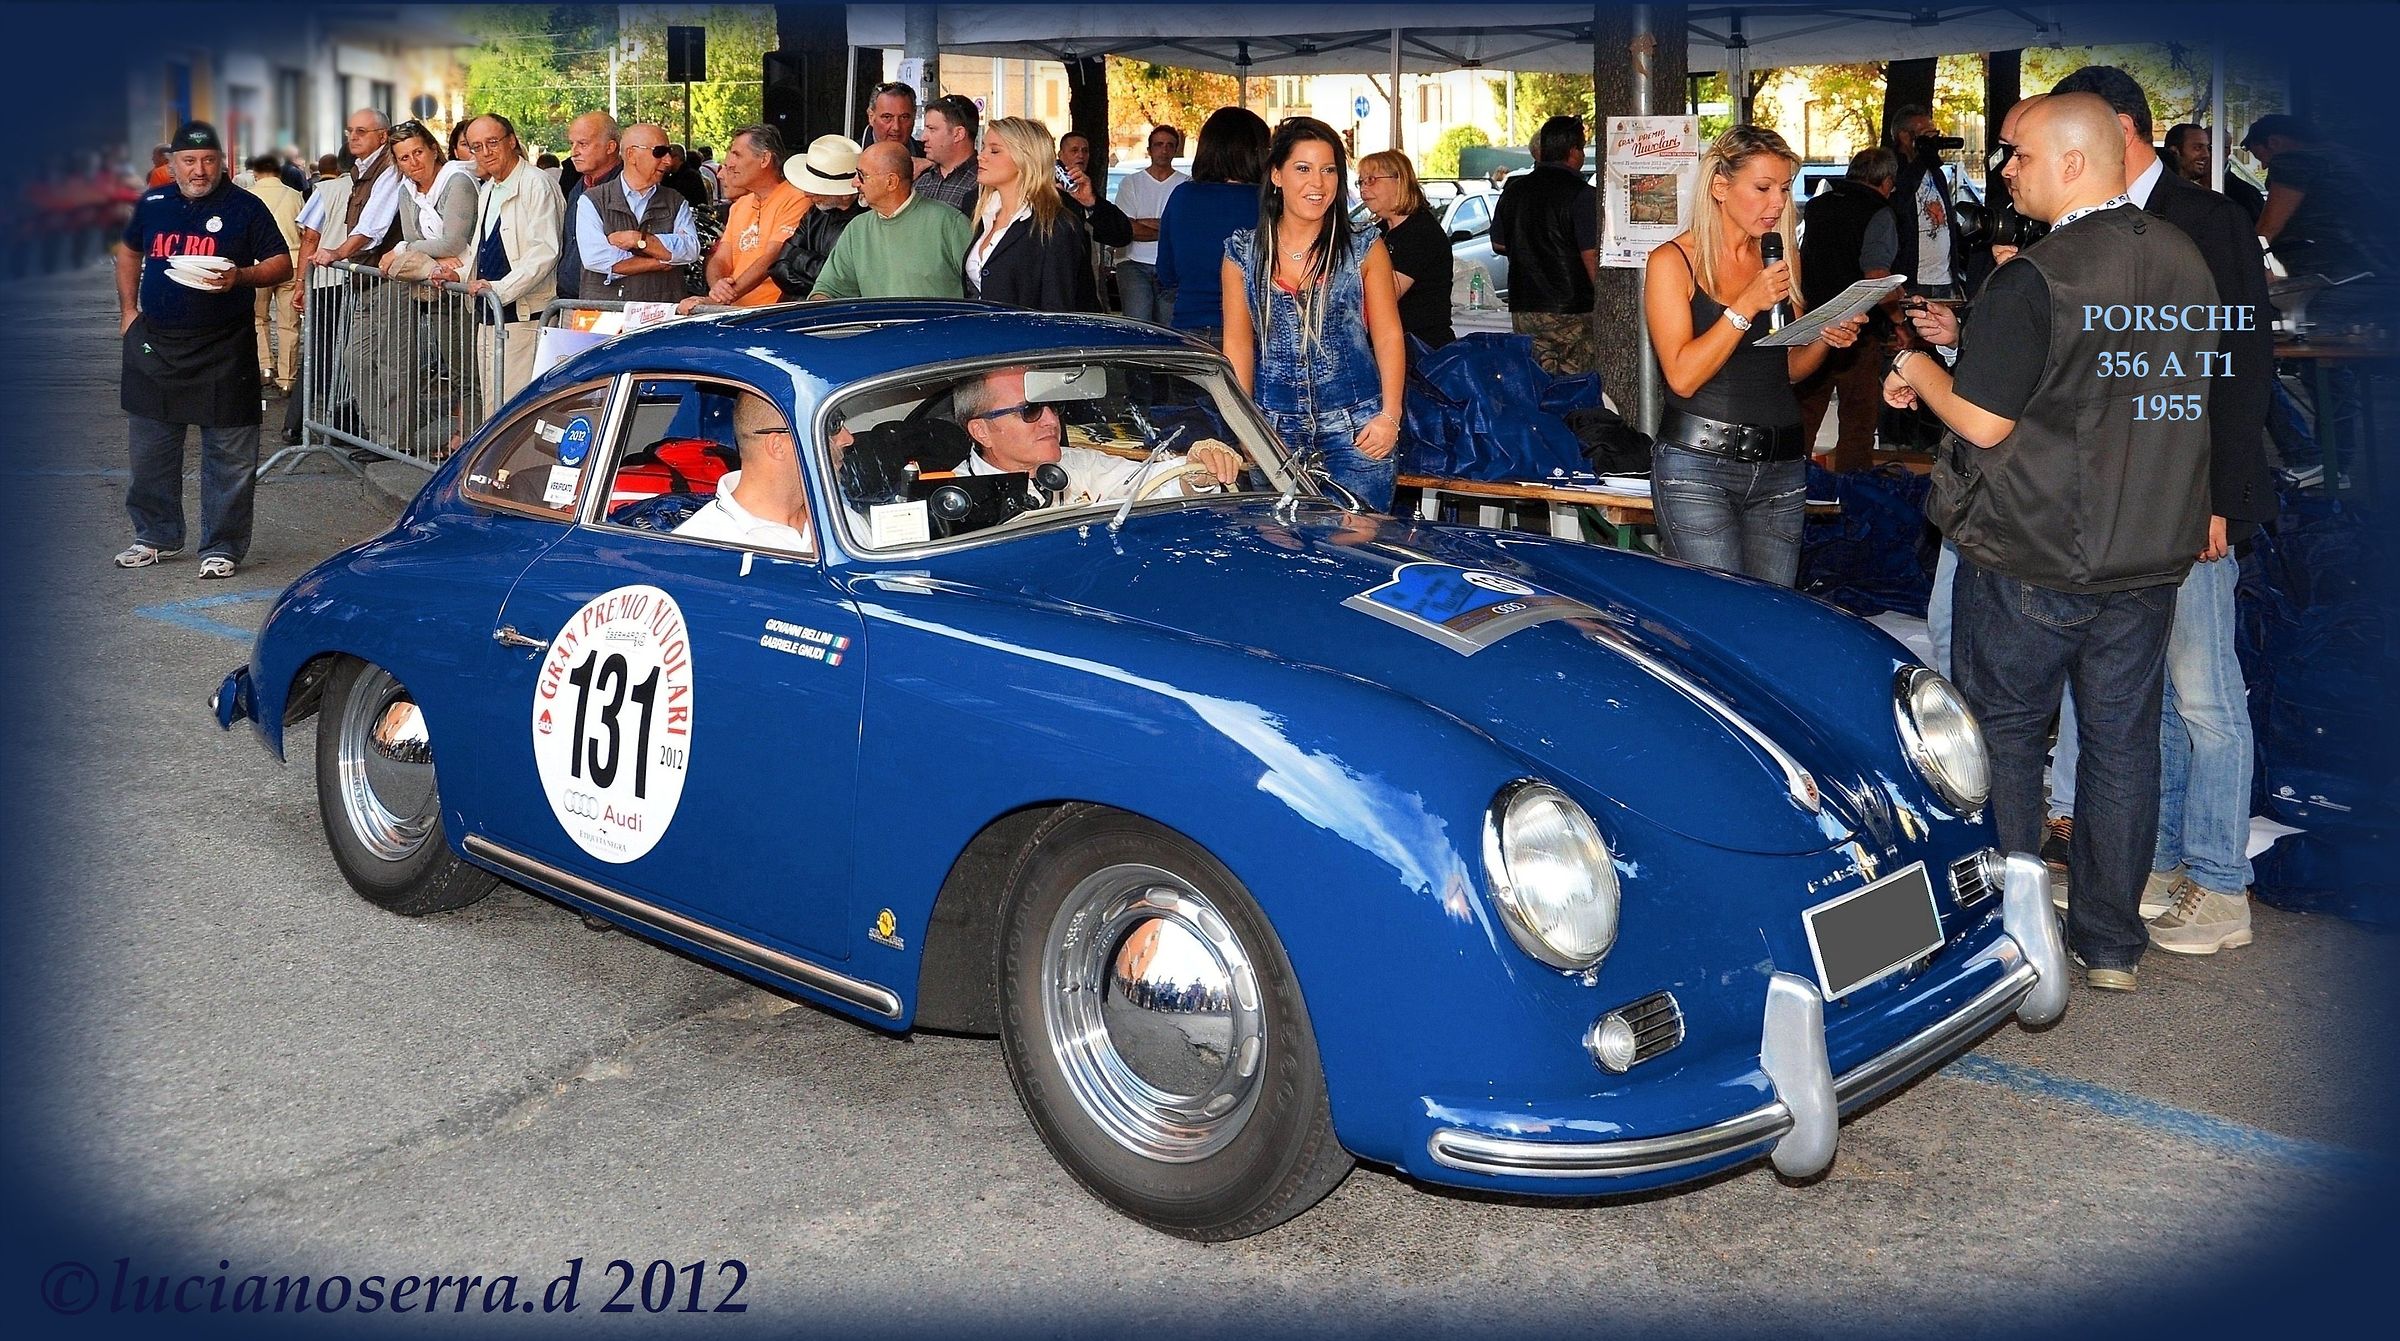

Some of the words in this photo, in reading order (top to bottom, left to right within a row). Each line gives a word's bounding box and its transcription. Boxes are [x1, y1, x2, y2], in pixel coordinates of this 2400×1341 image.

[150, 233, 180, 258] AC
[184, 234, 217, 257] BO
[568, 430, 587, 442] 2012
[760, 635, 799, 654] GABRIELE
[765, 618, 803, 637] GIOVANNI
[800, 627, 834, 645] BELLINI
[540, 628, 579, 699] GRAN
[582, 594, 648, 637] PREMIO
[644, 598, 688, 736] NUVOLARI
[569, 650, 661, 800] 131
[660, 745, 684, 770] 2012
[603, 805, 642, 832] Audi
